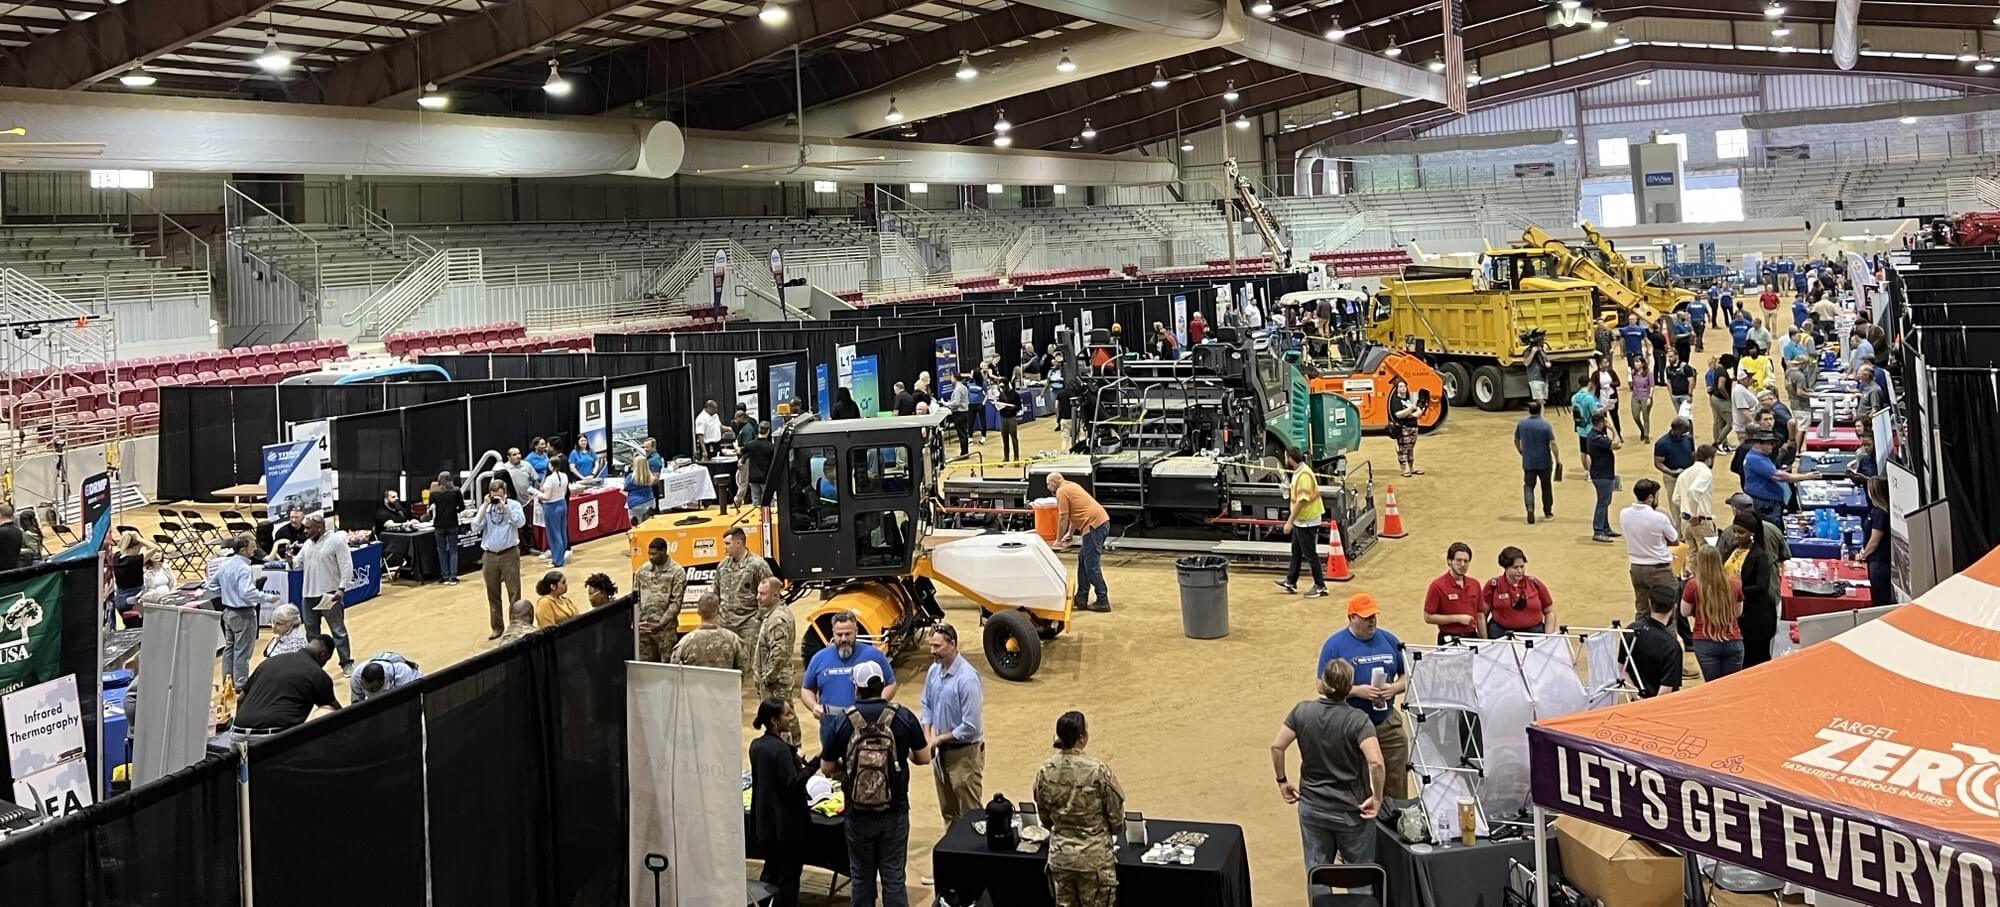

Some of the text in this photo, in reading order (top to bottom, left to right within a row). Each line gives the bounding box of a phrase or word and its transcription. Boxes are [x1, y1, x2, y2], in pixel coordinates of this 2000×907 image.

[738, 369, 756, 383] L13
[24, 702, 63, 725] Infrared
[1827, 717, 1898, 740] TARGET
[9, 714, 80, 744] Thermography
[1781, 761, 1954, 808] FATALITIES & SERIOUS INJURIES
[35, 789, 84, 819] EA
[1556, 745, 1670, 831] LET'S
[1680, 779, 1770, 860] GET
